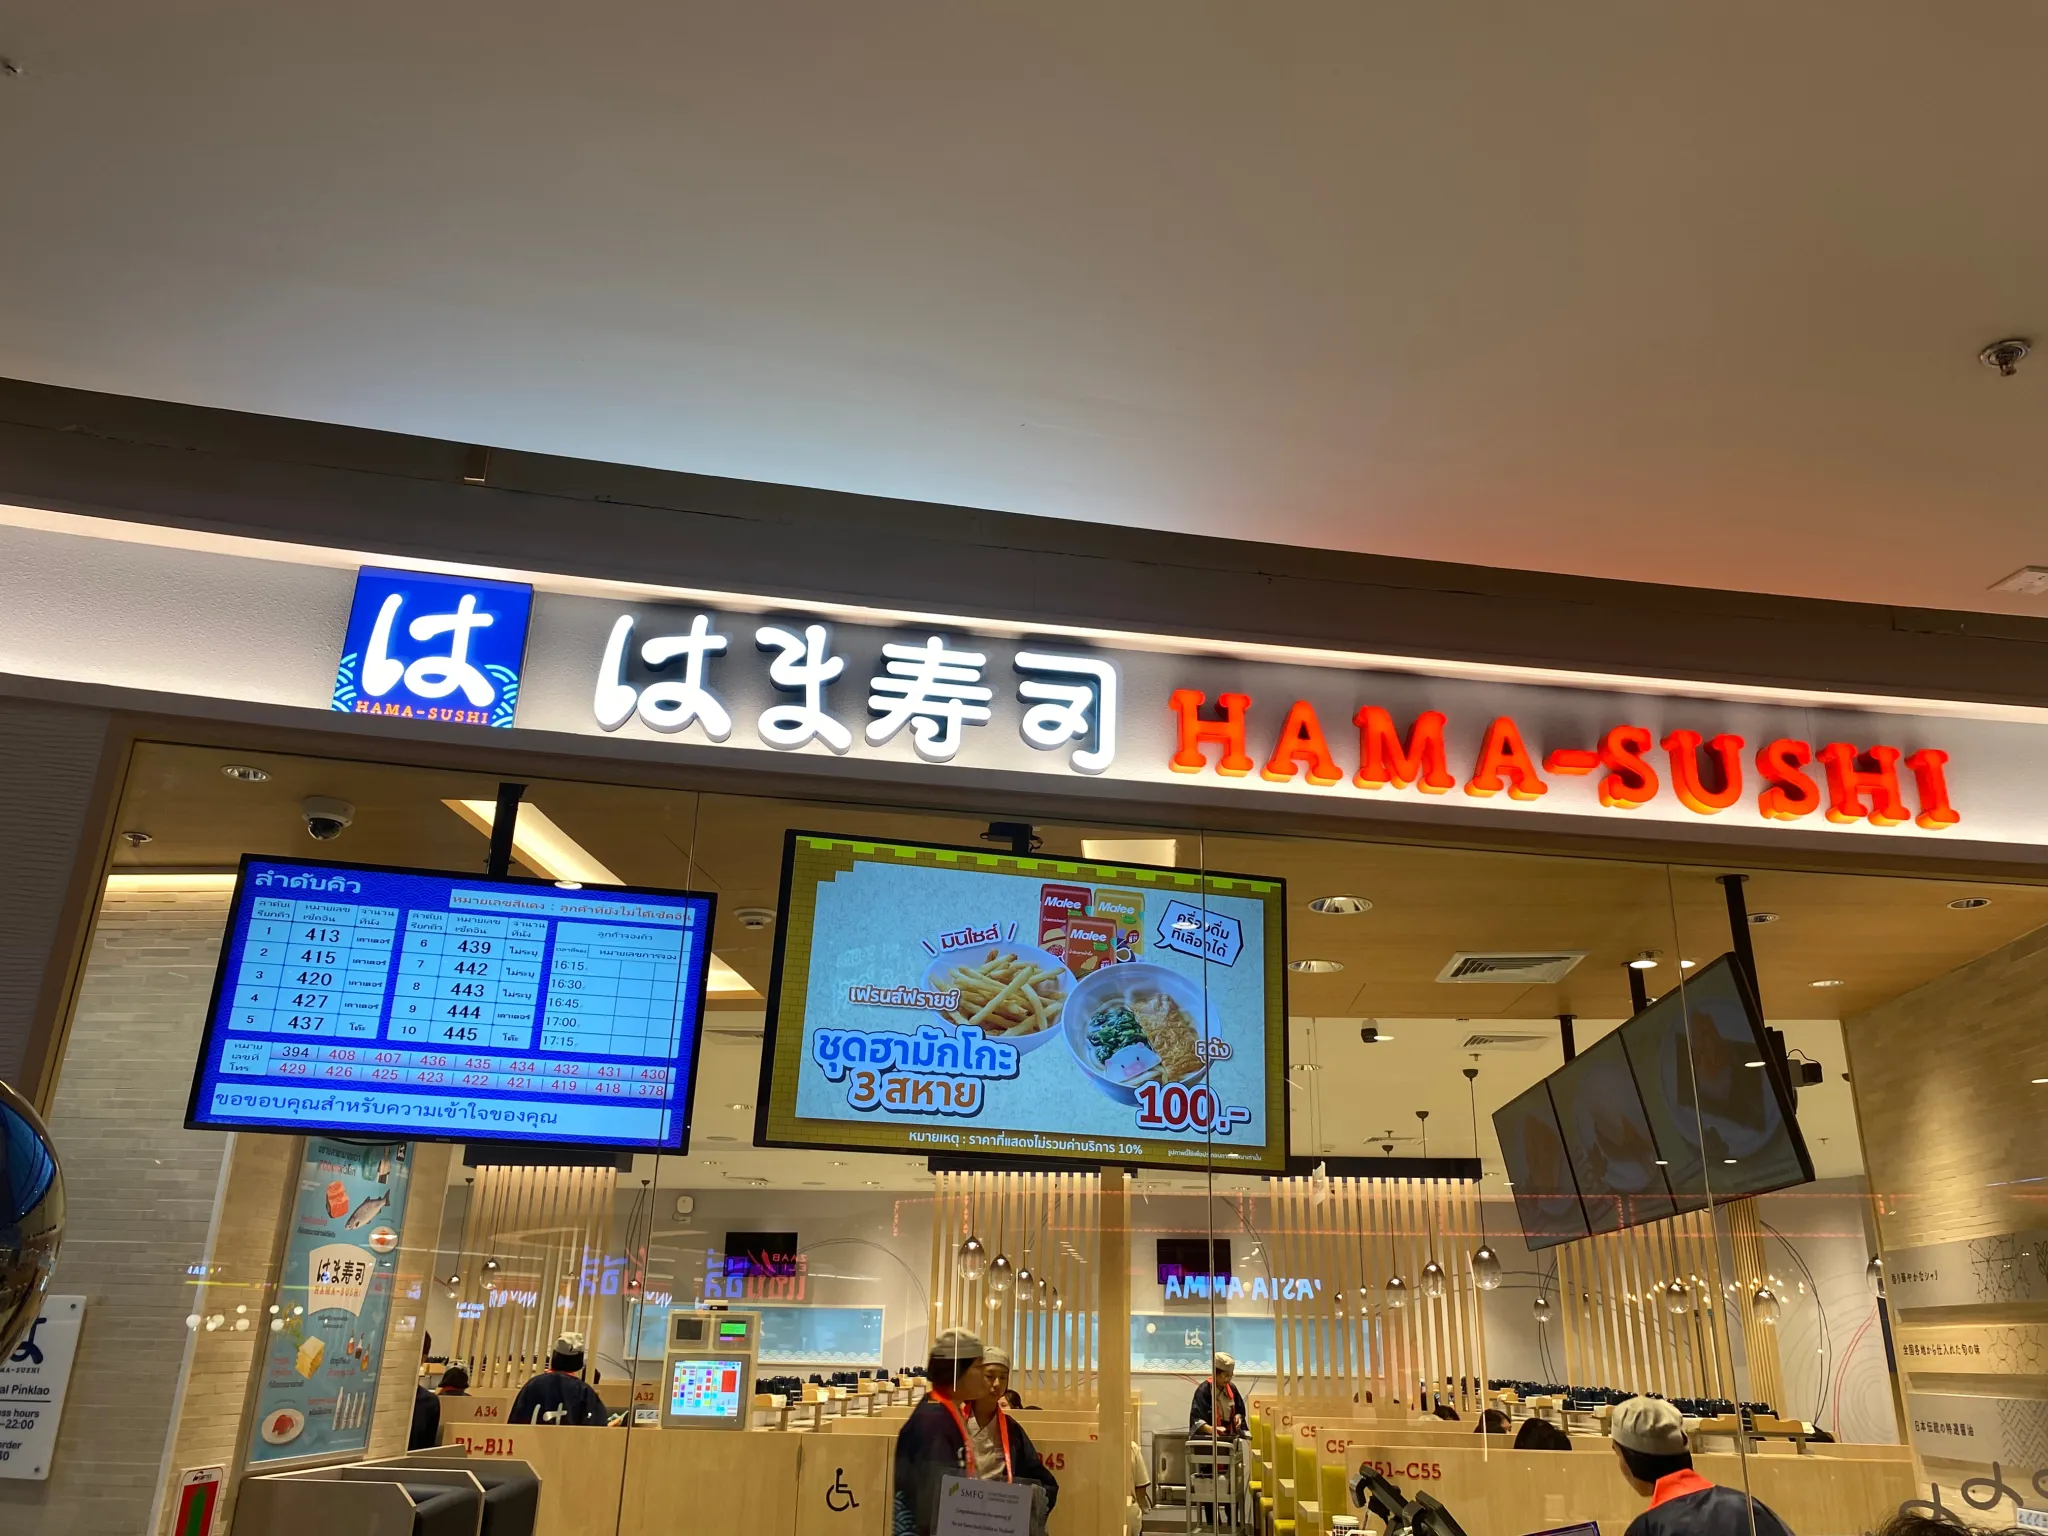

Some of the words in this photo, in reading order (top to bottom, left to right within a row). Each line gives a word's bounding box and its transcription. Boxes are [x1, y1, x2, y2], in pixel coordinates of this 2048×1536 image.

[361, 593, 499, 706] は
[593, 613, 1118, 774] はま寿司
[355, 700, 489, 724] HAMA-SUSHI
[1168, 688, 1961, 830] HAMA-SUSHI
[255, 869, 361, 894] ลำดับคิว
[452, 894, 545, 911] หมายเลขสีแดง
[1044, 896, 1082, 909] Malee
[1098, 901, 1135, 914] Malee
[266, 927, 271, 935] 1
[305, 928, 340, 943] 413
[940, 923, 999, 949] มินิไซส์
[1069, 929, 1107, 942] Malee
[260, 948, 268, 957] 2
[300, 950, 337, 965] 415
[420, 939, 427, 948] 6
[457, 940, 491, 954] 439
[509, 946, 538, 957] ไม่ระบุ
[416, 960, 424, 968] 7
[454, 962, 488, 976] 442
[505, 967, 535, 979] ไม่ระบุ
[255, 971, 263, 979] 3
[296, 972, 332, 986] 420
[412, 982, 420, 990] 8
[450, 983, 484, 997] 443
[502, 989, 532, 1000] ไม่ระบุ
[250, 994, 258, 1002] 4
[292, 994, 328, 1009] 427
[409, 1005, 416, 1013] 9
[447, 1004, 481, 1019] 444
[246, 1015, 255, 1024] 5
[288, 1016, 324, 1031] 437
[401, 1026, 417, 1034] 10
[443, 1026, 478, 1041] 445
[819, 1030, 1012, 1073] ชุดฮามักโกะ
[282, 1046, 309, 1058] 394
[329, 1049, 356, 1061] 408
[374, 1052, 401, 1064] 407
[420, 1055, 446, 1067] 436
[465, 1058, 491, 1070] 435
[509, 1061, 535, 1073] 434
[553, 1064, 580, 1076] 432
[597, 1066, 621, 1078] 431
[640, 1069, 666, 1080] 430
[279, 1063, 306, 1074] 429
[325, 1066, 352, 1077] 426
[371, 1069, 398, 1080] 425
[417, 1072, 443, 1083] 423
[462, 1075, 489, 1086] 422
[507, 1077, 532, 1089] 421
[551, 1080, 577, 1092] 419
[595, 1083, 621, 1094] 418
[638, 1085, 664, 1096] 378
[854, 1071, 875, 1102] 3
[885, 1076, 976, 1108] สหาย
[215, 1092, 558, 1128] ขอขอบคุณสำหรับความเข้าใจของคุณ
[1138, 1085, 1246, 1128] 100.-
[909, 1131, 960, 1148] หมายเหตุ
[969, 1131, 1116, 1153] ราคาที่แสดงไม่รวมค่าบริการ
[1118, 1143, 1143, 1155] 10%
[11, 1384, 50, 1395] Pinklao
[635, 1392, 654, 1401] A32
[14, 1409, 40, 1418] hours
[474, 1406, 498, 1417] A34
[960, 1488, 984, 1500] SMFG
